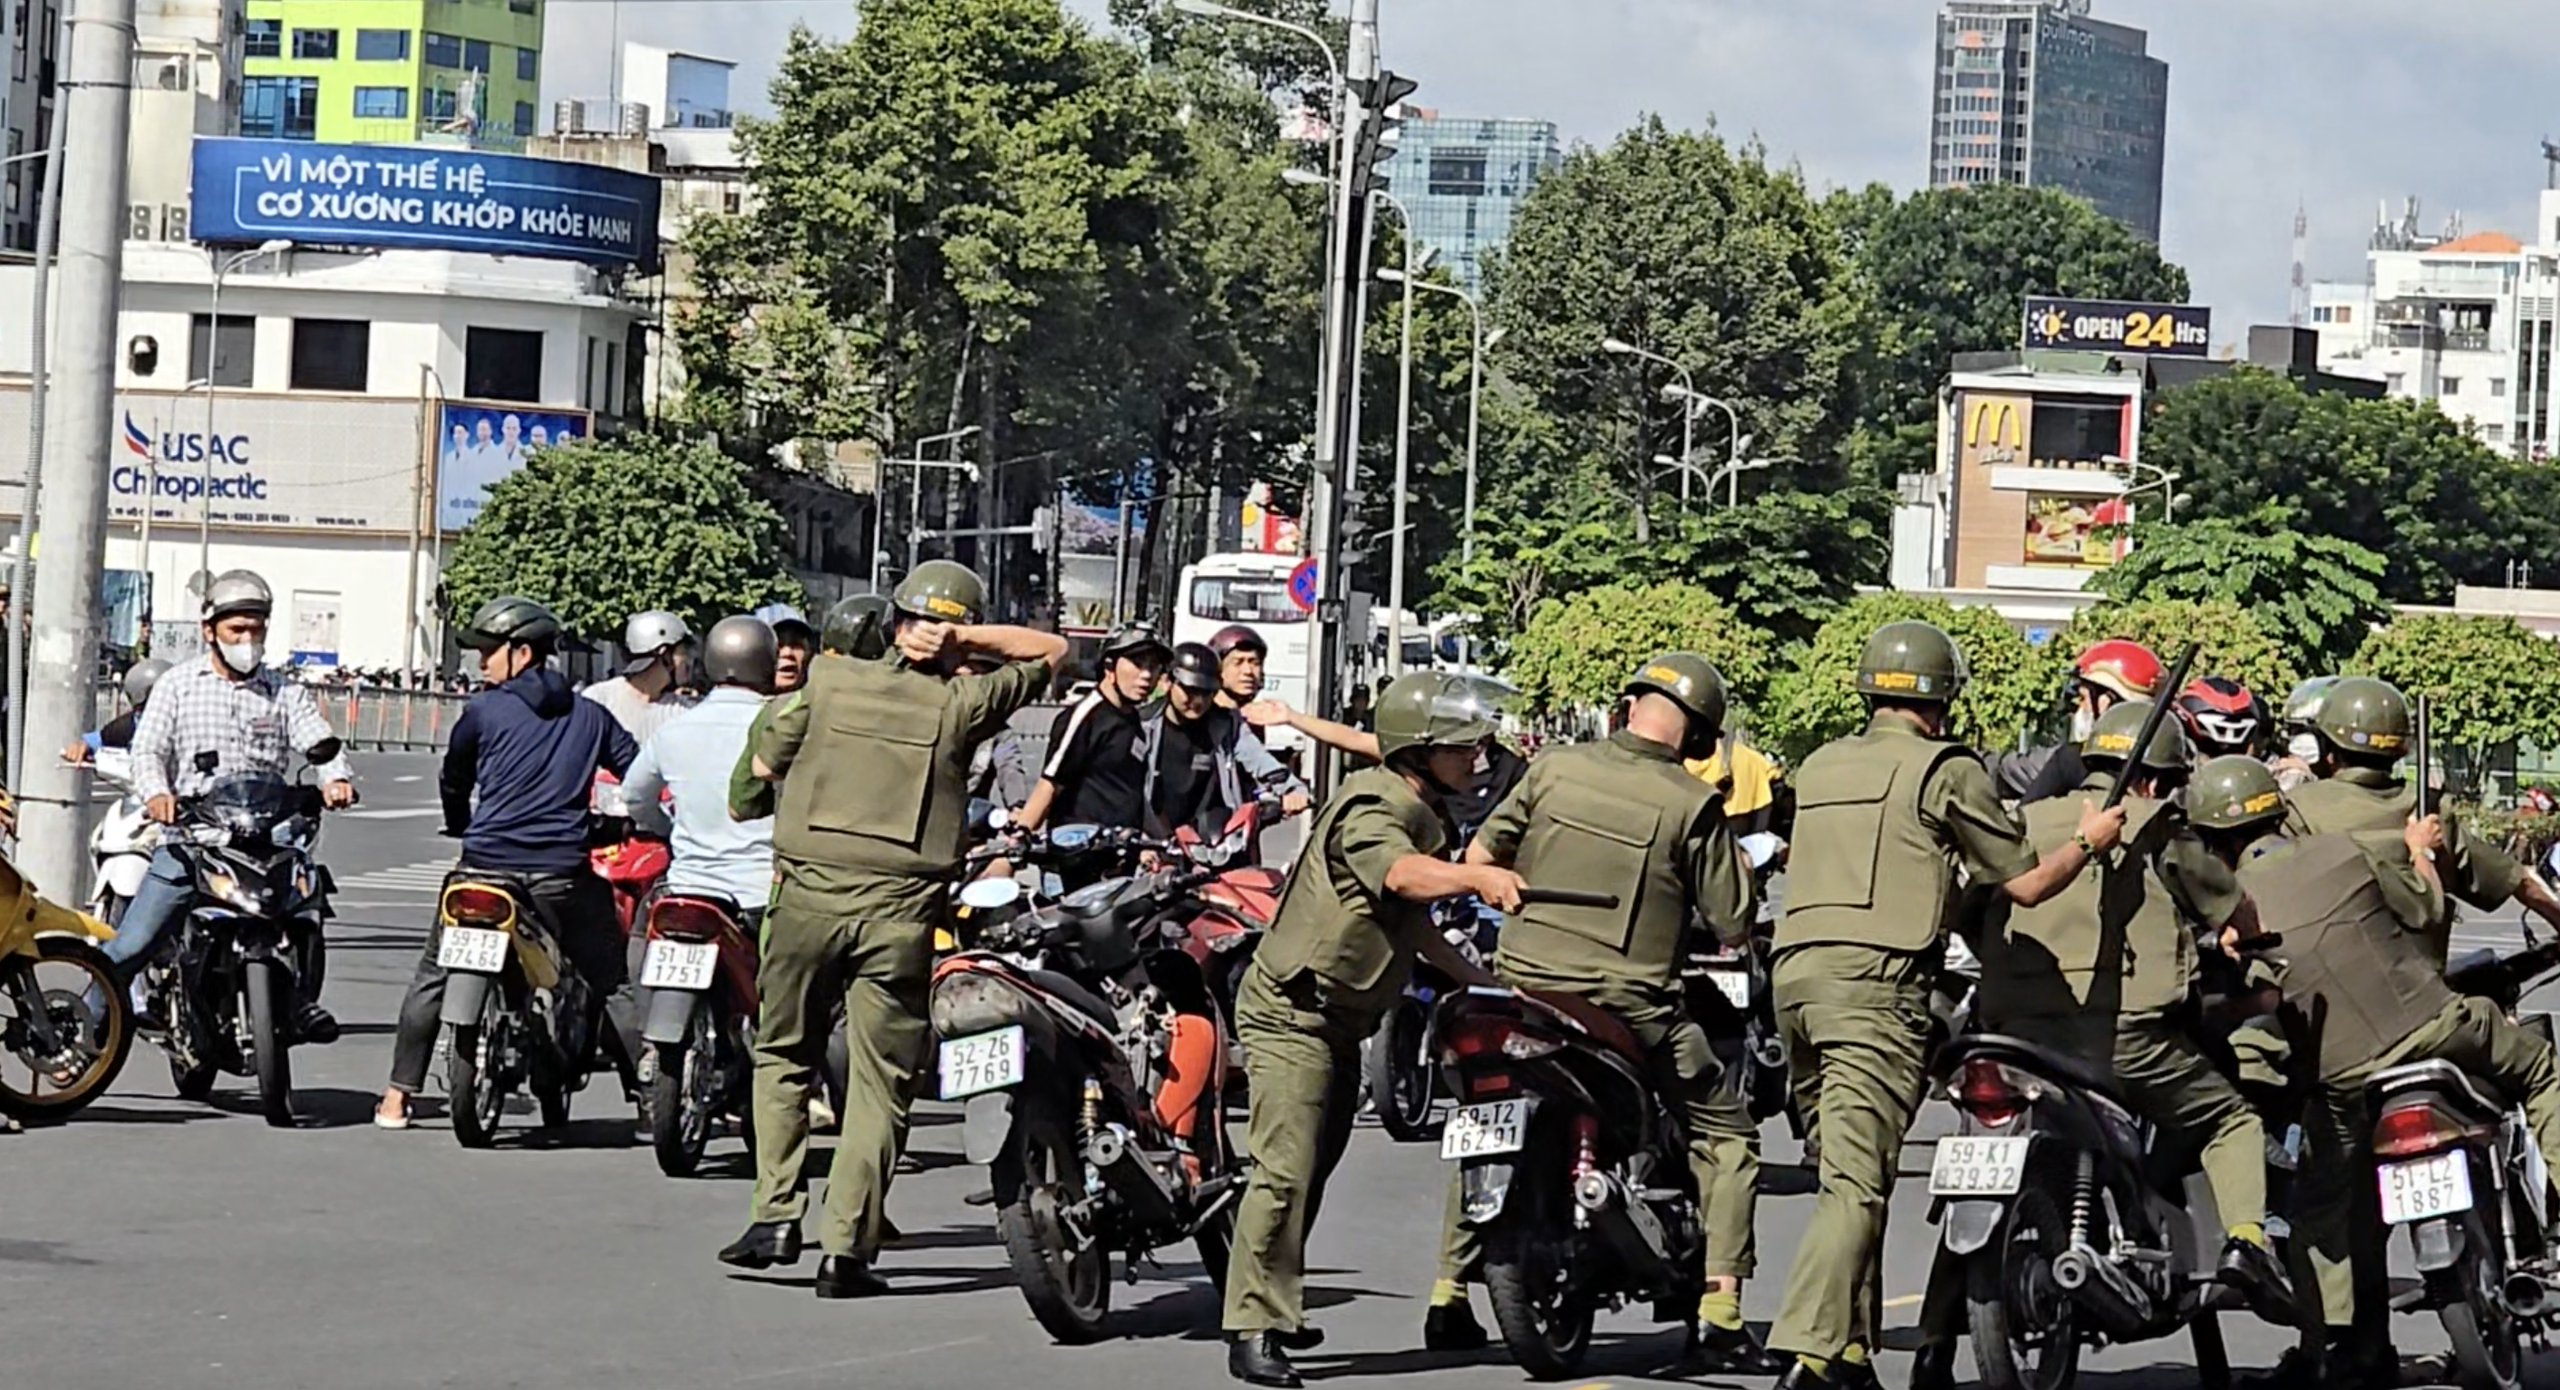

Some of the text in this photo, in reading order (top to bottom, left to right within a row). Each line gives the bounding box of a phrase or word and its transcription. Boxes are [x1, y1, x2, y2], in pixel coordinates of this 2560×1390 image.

[262, 152, 486, 199] VÌ MỘT THẾ HỆ
[257, 188, 632, 246] CƠ XƯƠNG KHỚP KHỎE MẠNH
[2073, 311, 2207, 348] OPEN 24 Hrs
[163, 432, 249, 465] USAC
[450, 929, 500, 950] 59-T3
[655, 965, 702, 984] 1751
[954, 1034, 1010, 1067] 52-Z6
[954, 1058, 1010, 1090] 7769
[1456, 1102, 1515, 1130] 59-T2
[1448, 1124, 1517, 1155] 162.91
[1949, 1142, 2010, 1164] 59-K1
[2393, 1157, 2453, 1191] 51-L2
[2395, 1183, 2454, 1217] 1887
